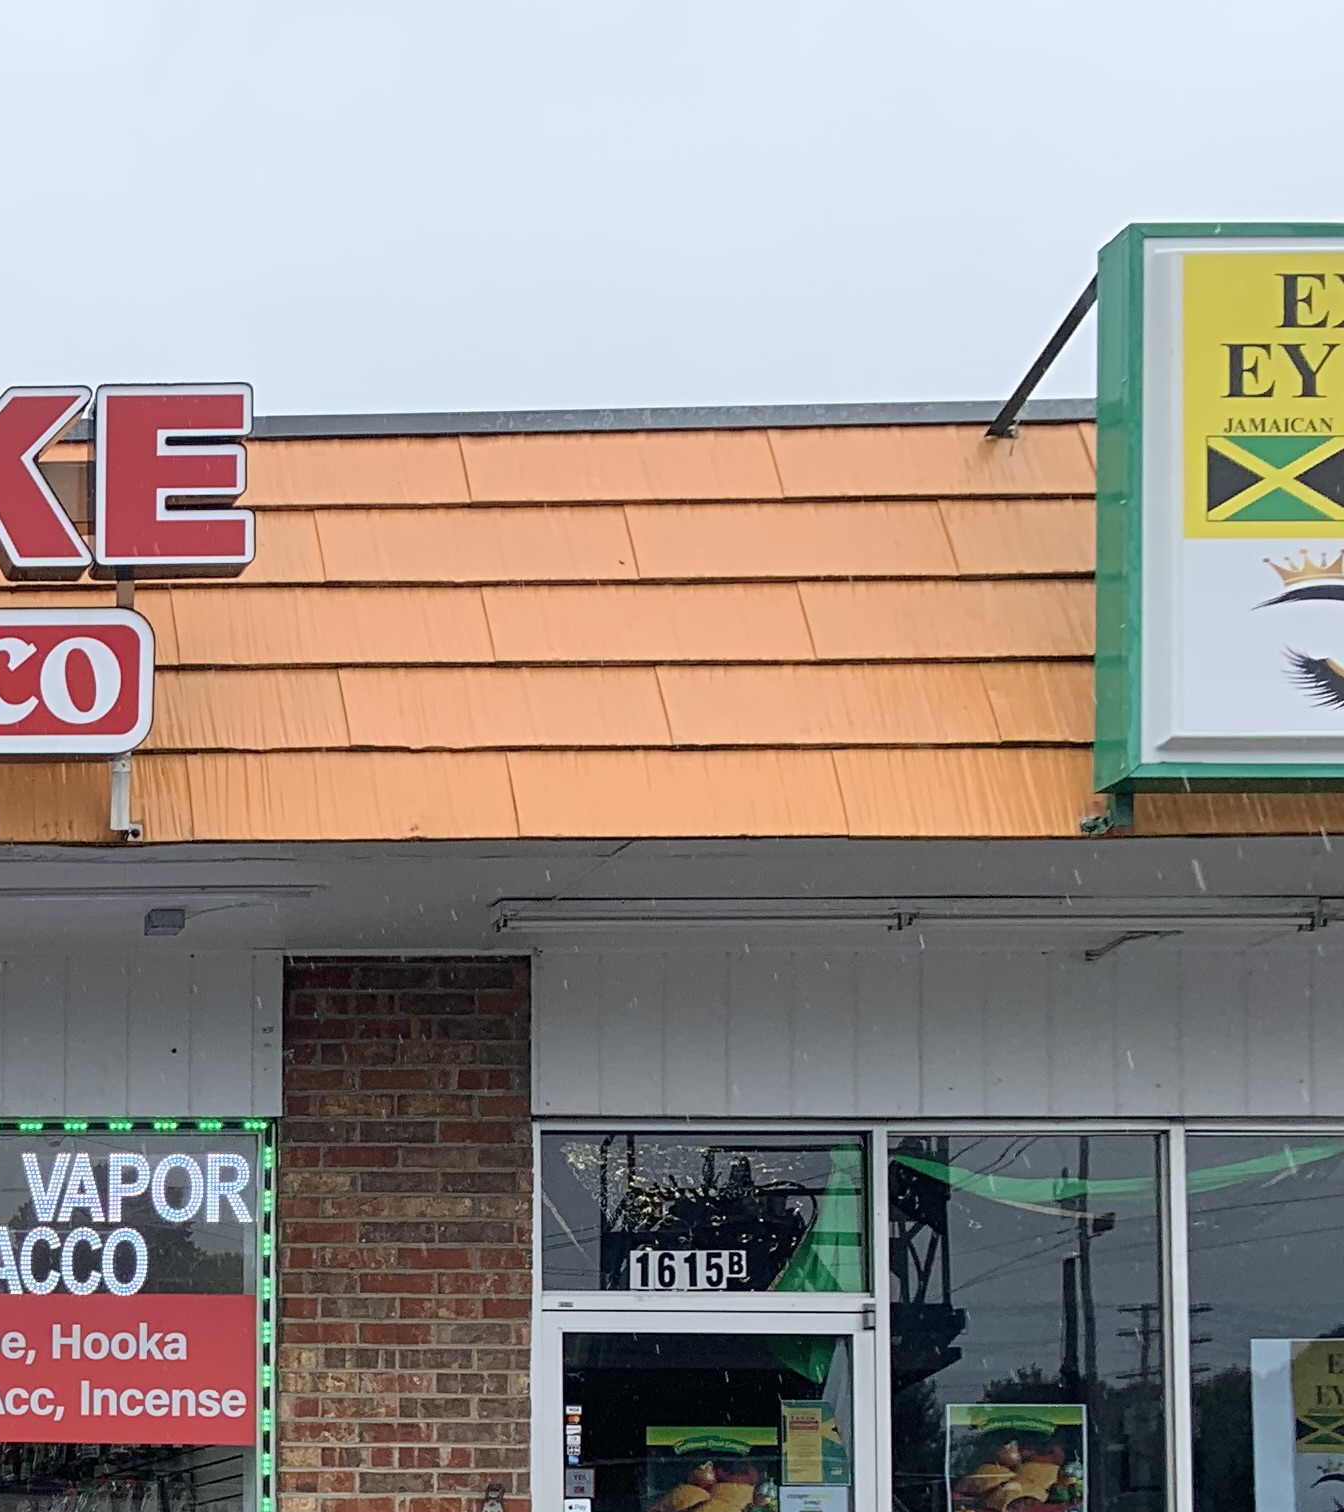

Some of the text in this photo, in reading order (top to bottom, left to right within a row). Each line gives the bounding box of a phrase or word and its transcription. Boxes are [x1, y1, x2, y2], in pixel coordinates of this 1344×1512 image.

[1223, 416, 1334, 433] JAMAICAN
[21, 1151, 253, 1224] VAPOR
[635, 1251, 745, 1289] 1615 B
[51, 1322, 188, 1360] Hooka
[80, 1379, 247, 1419] Incense
